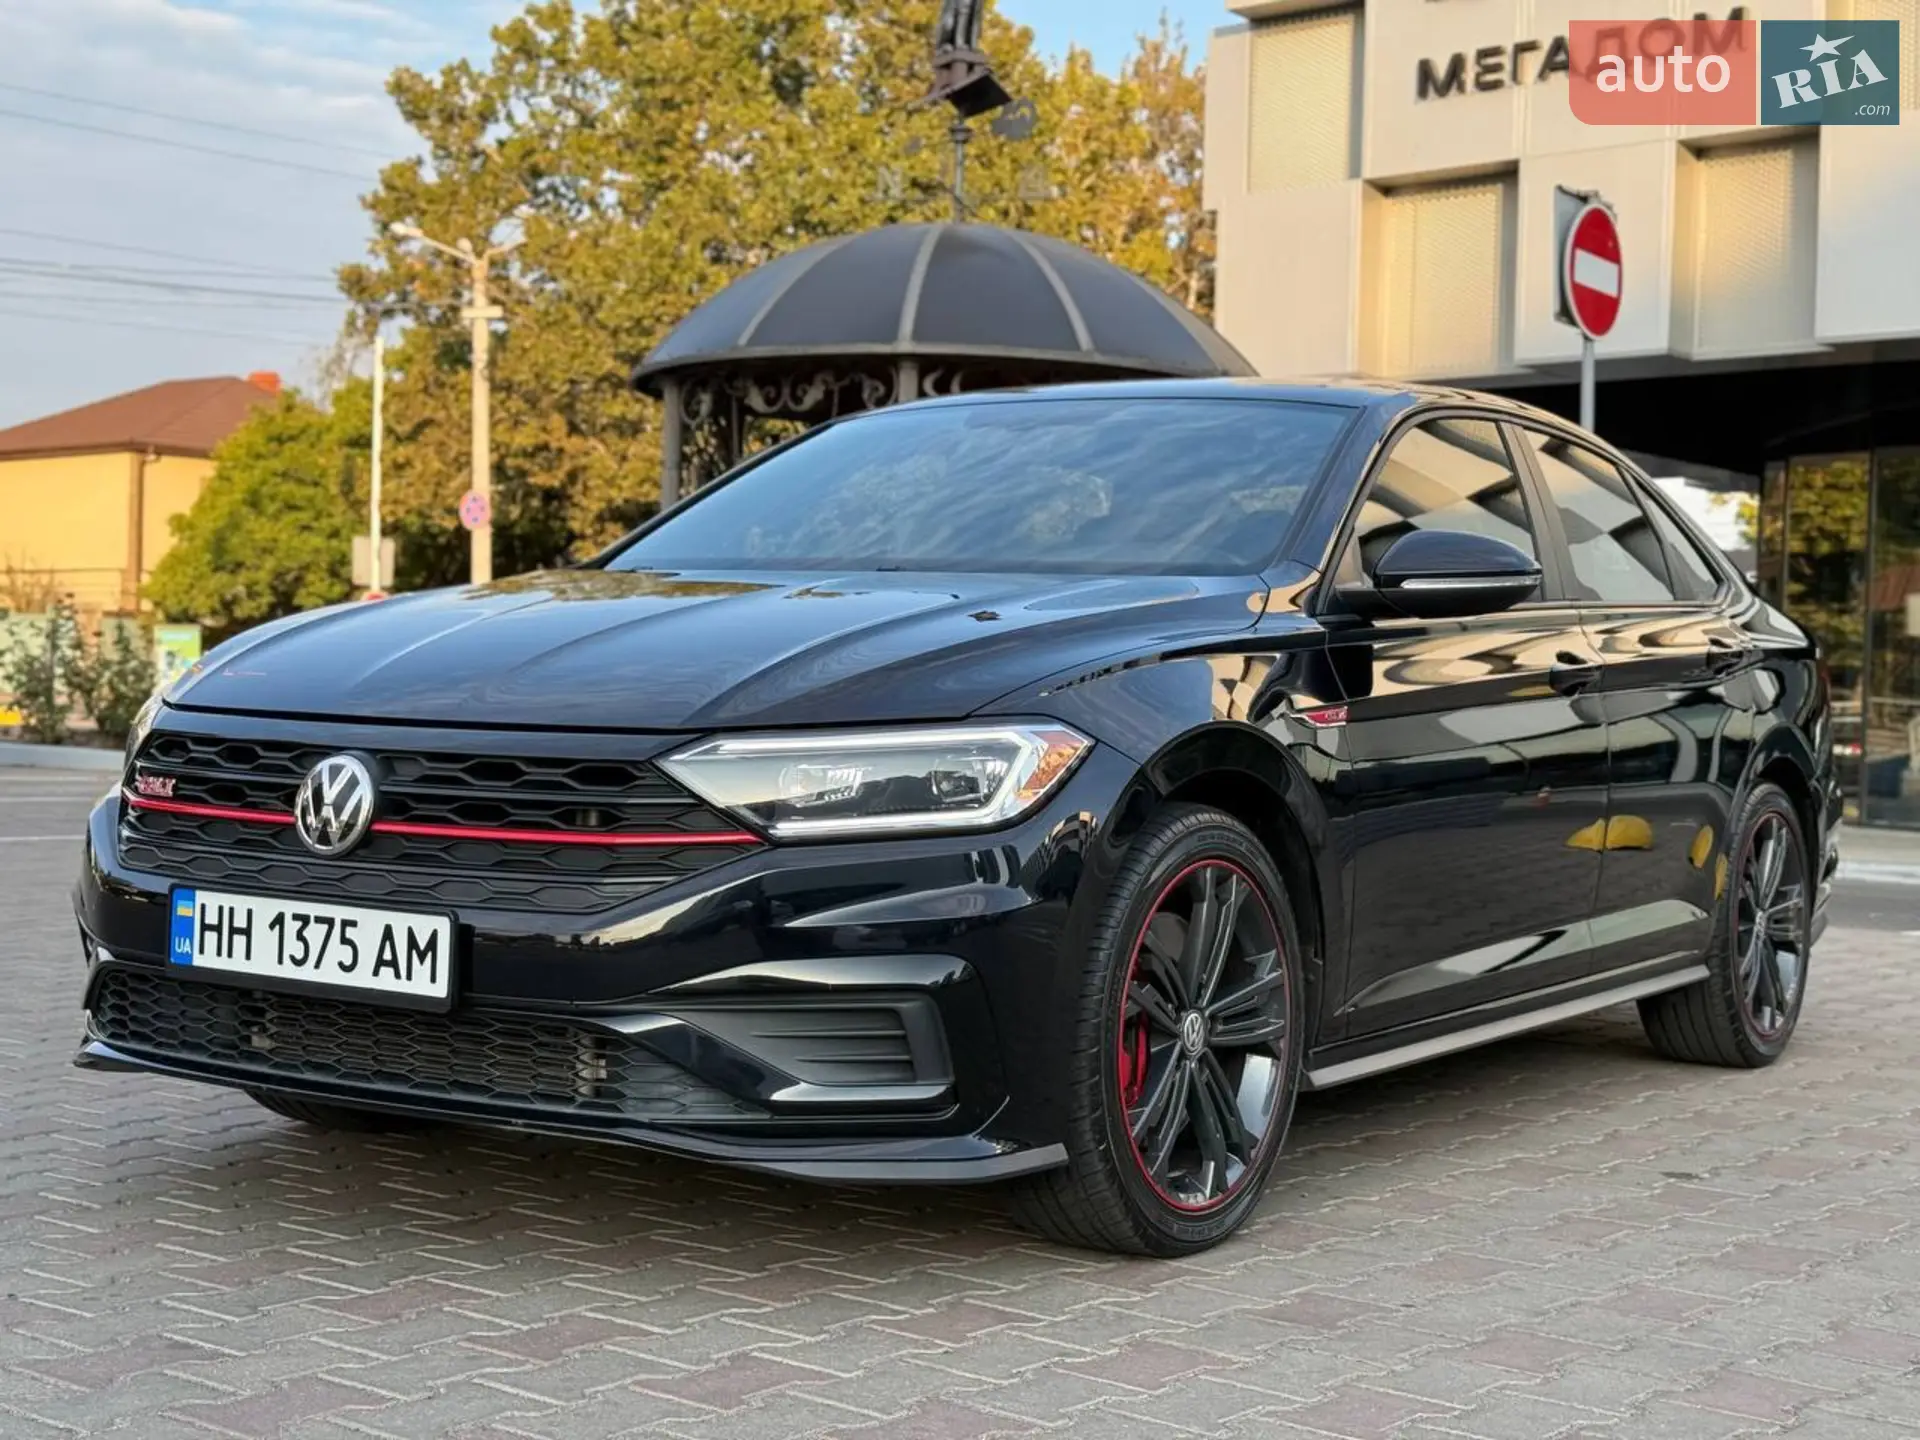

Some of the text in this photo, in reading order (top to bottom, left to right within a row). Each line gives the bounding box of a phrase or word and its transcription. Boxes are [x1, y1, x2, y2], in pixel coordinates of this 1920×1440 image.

[175, 937, 192, 955] UA
[199, 903, 439, 984] HH 1375 AM
